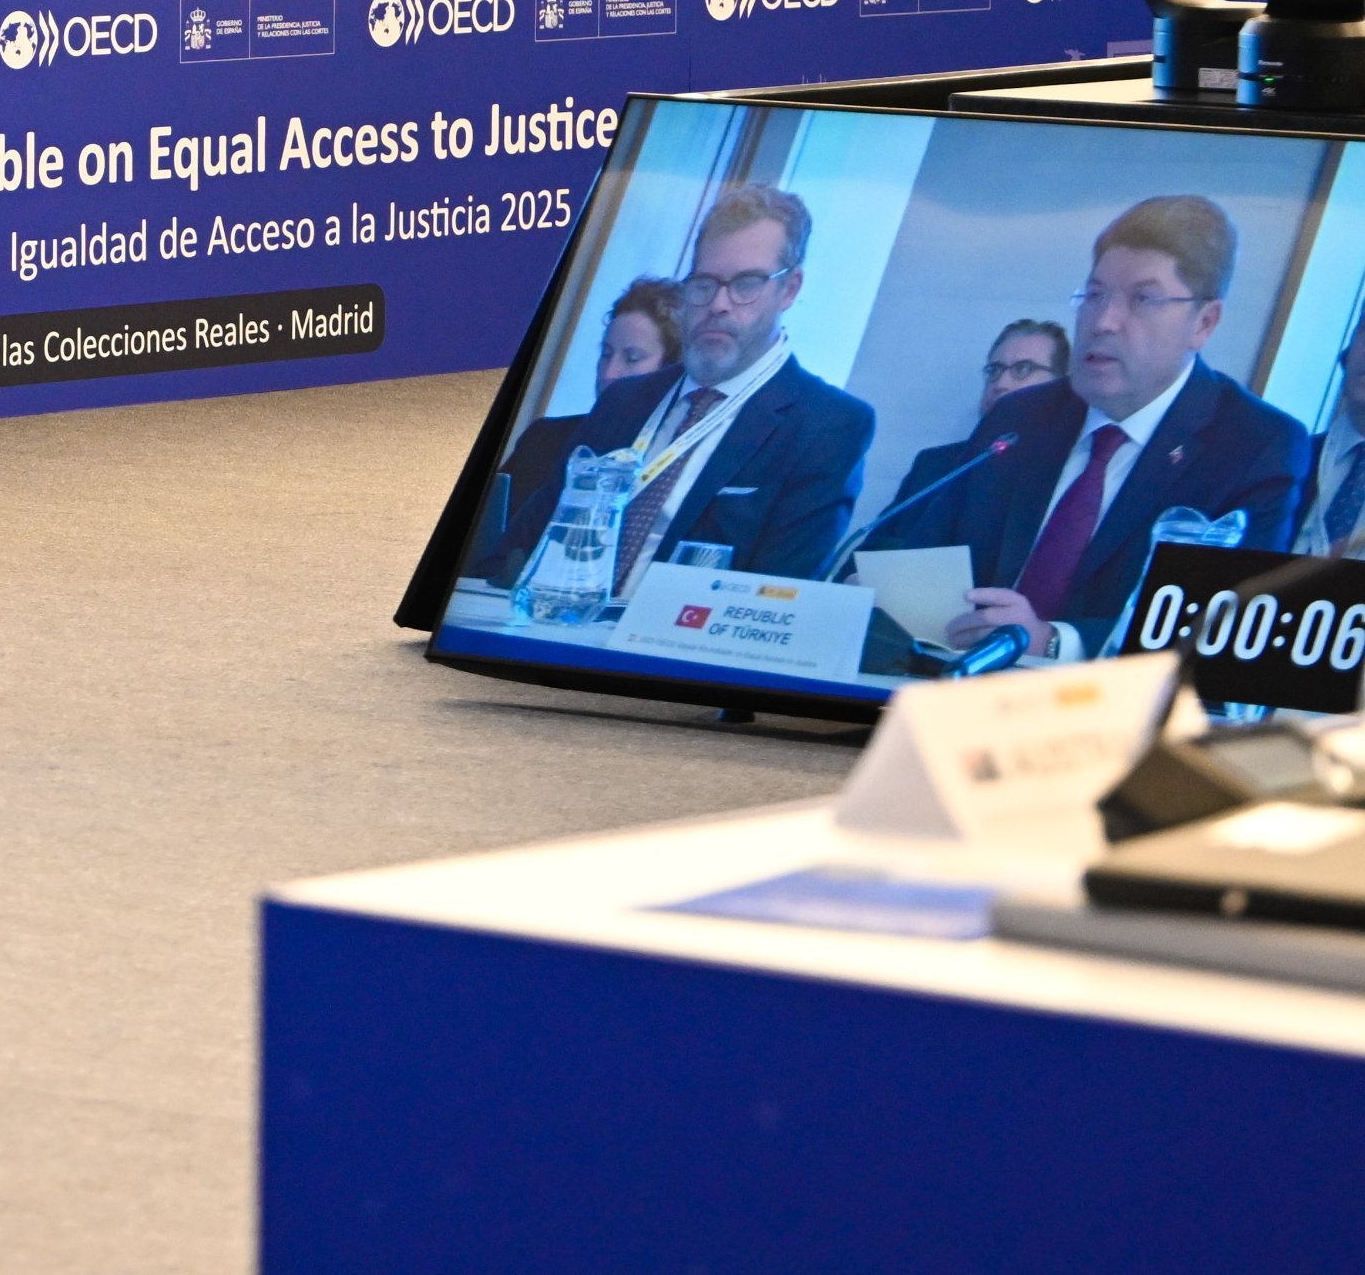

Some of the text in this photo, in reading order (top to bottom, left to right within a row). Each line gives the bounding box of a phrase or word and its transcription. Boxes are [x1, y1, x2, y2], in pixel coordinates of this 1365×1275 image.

[64, 14, 157, 56] OECD
[79, 142, 132, 184] on
[150, 116, 265, 190] Equal
[280, 117, 417, 170] Access
[431, 112, 472, 158] to
[485, 97, 617, 155] Justice
[12, 219, 146, 280] Igualdad
[160, 217, 196, 259] de
[208, 216, 314, 255] Acceso
[325, 216, 339, 245] a
[353, 202, 374, 243] la
[385, 196, 489, 240] Justicia
[501, 189, 570, 230] 2025
[3, 334, 34, 366] las
[44, 325, 186, 362] Colecciones
[196, 313, 269, 348] Reales
[292, 302, 372, 339] Madrid
[709, 623, 729, 636] OF
[723, 605, 795, 625] REPUBLIC
[1140, 585, 1365, 670] 0:00:06
